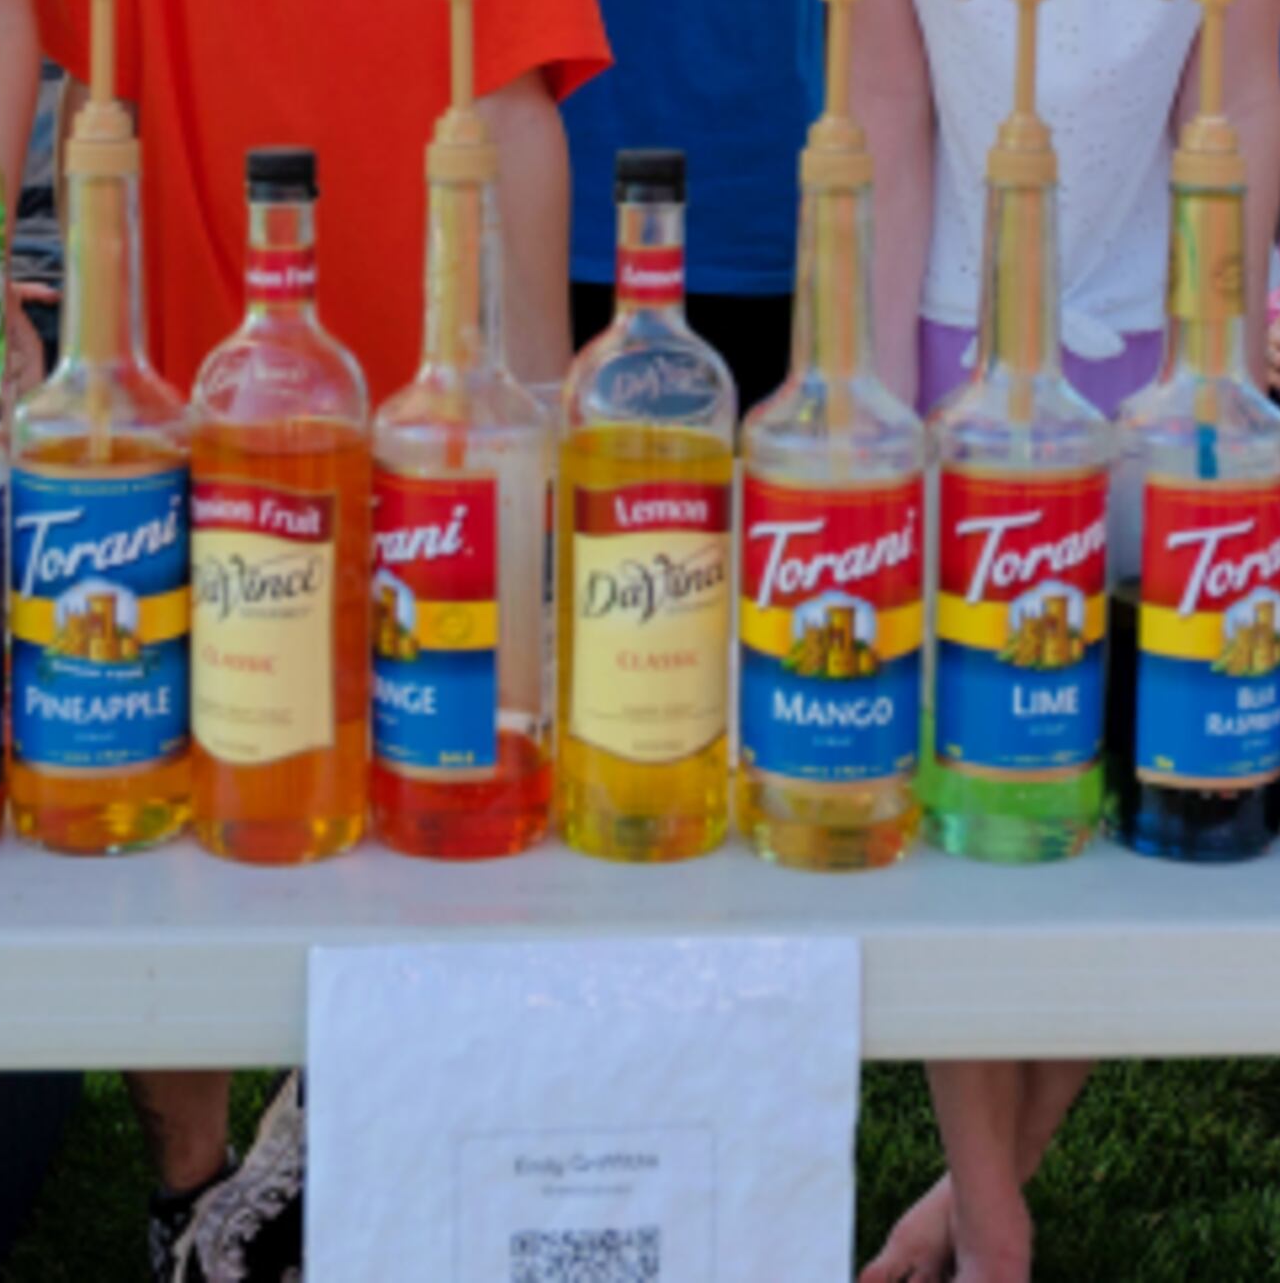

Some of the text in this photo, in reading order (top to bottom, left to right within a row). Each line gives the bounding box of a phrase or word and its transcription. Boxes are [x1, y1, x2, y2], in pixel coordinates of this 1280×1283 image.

[373, 505, 468, 565] rani
[615, 496, 708, 526] Lemon
[16, 494, 182, 600] Torani
[750, 508, 915, 611] Torani
[956, 510, 1105, 605] Toran
[25, 684, 171, 725] PINEAPPLE
[773, 686, 894, 726] MANGO
[1012, 685, 1080, 716] LIME
